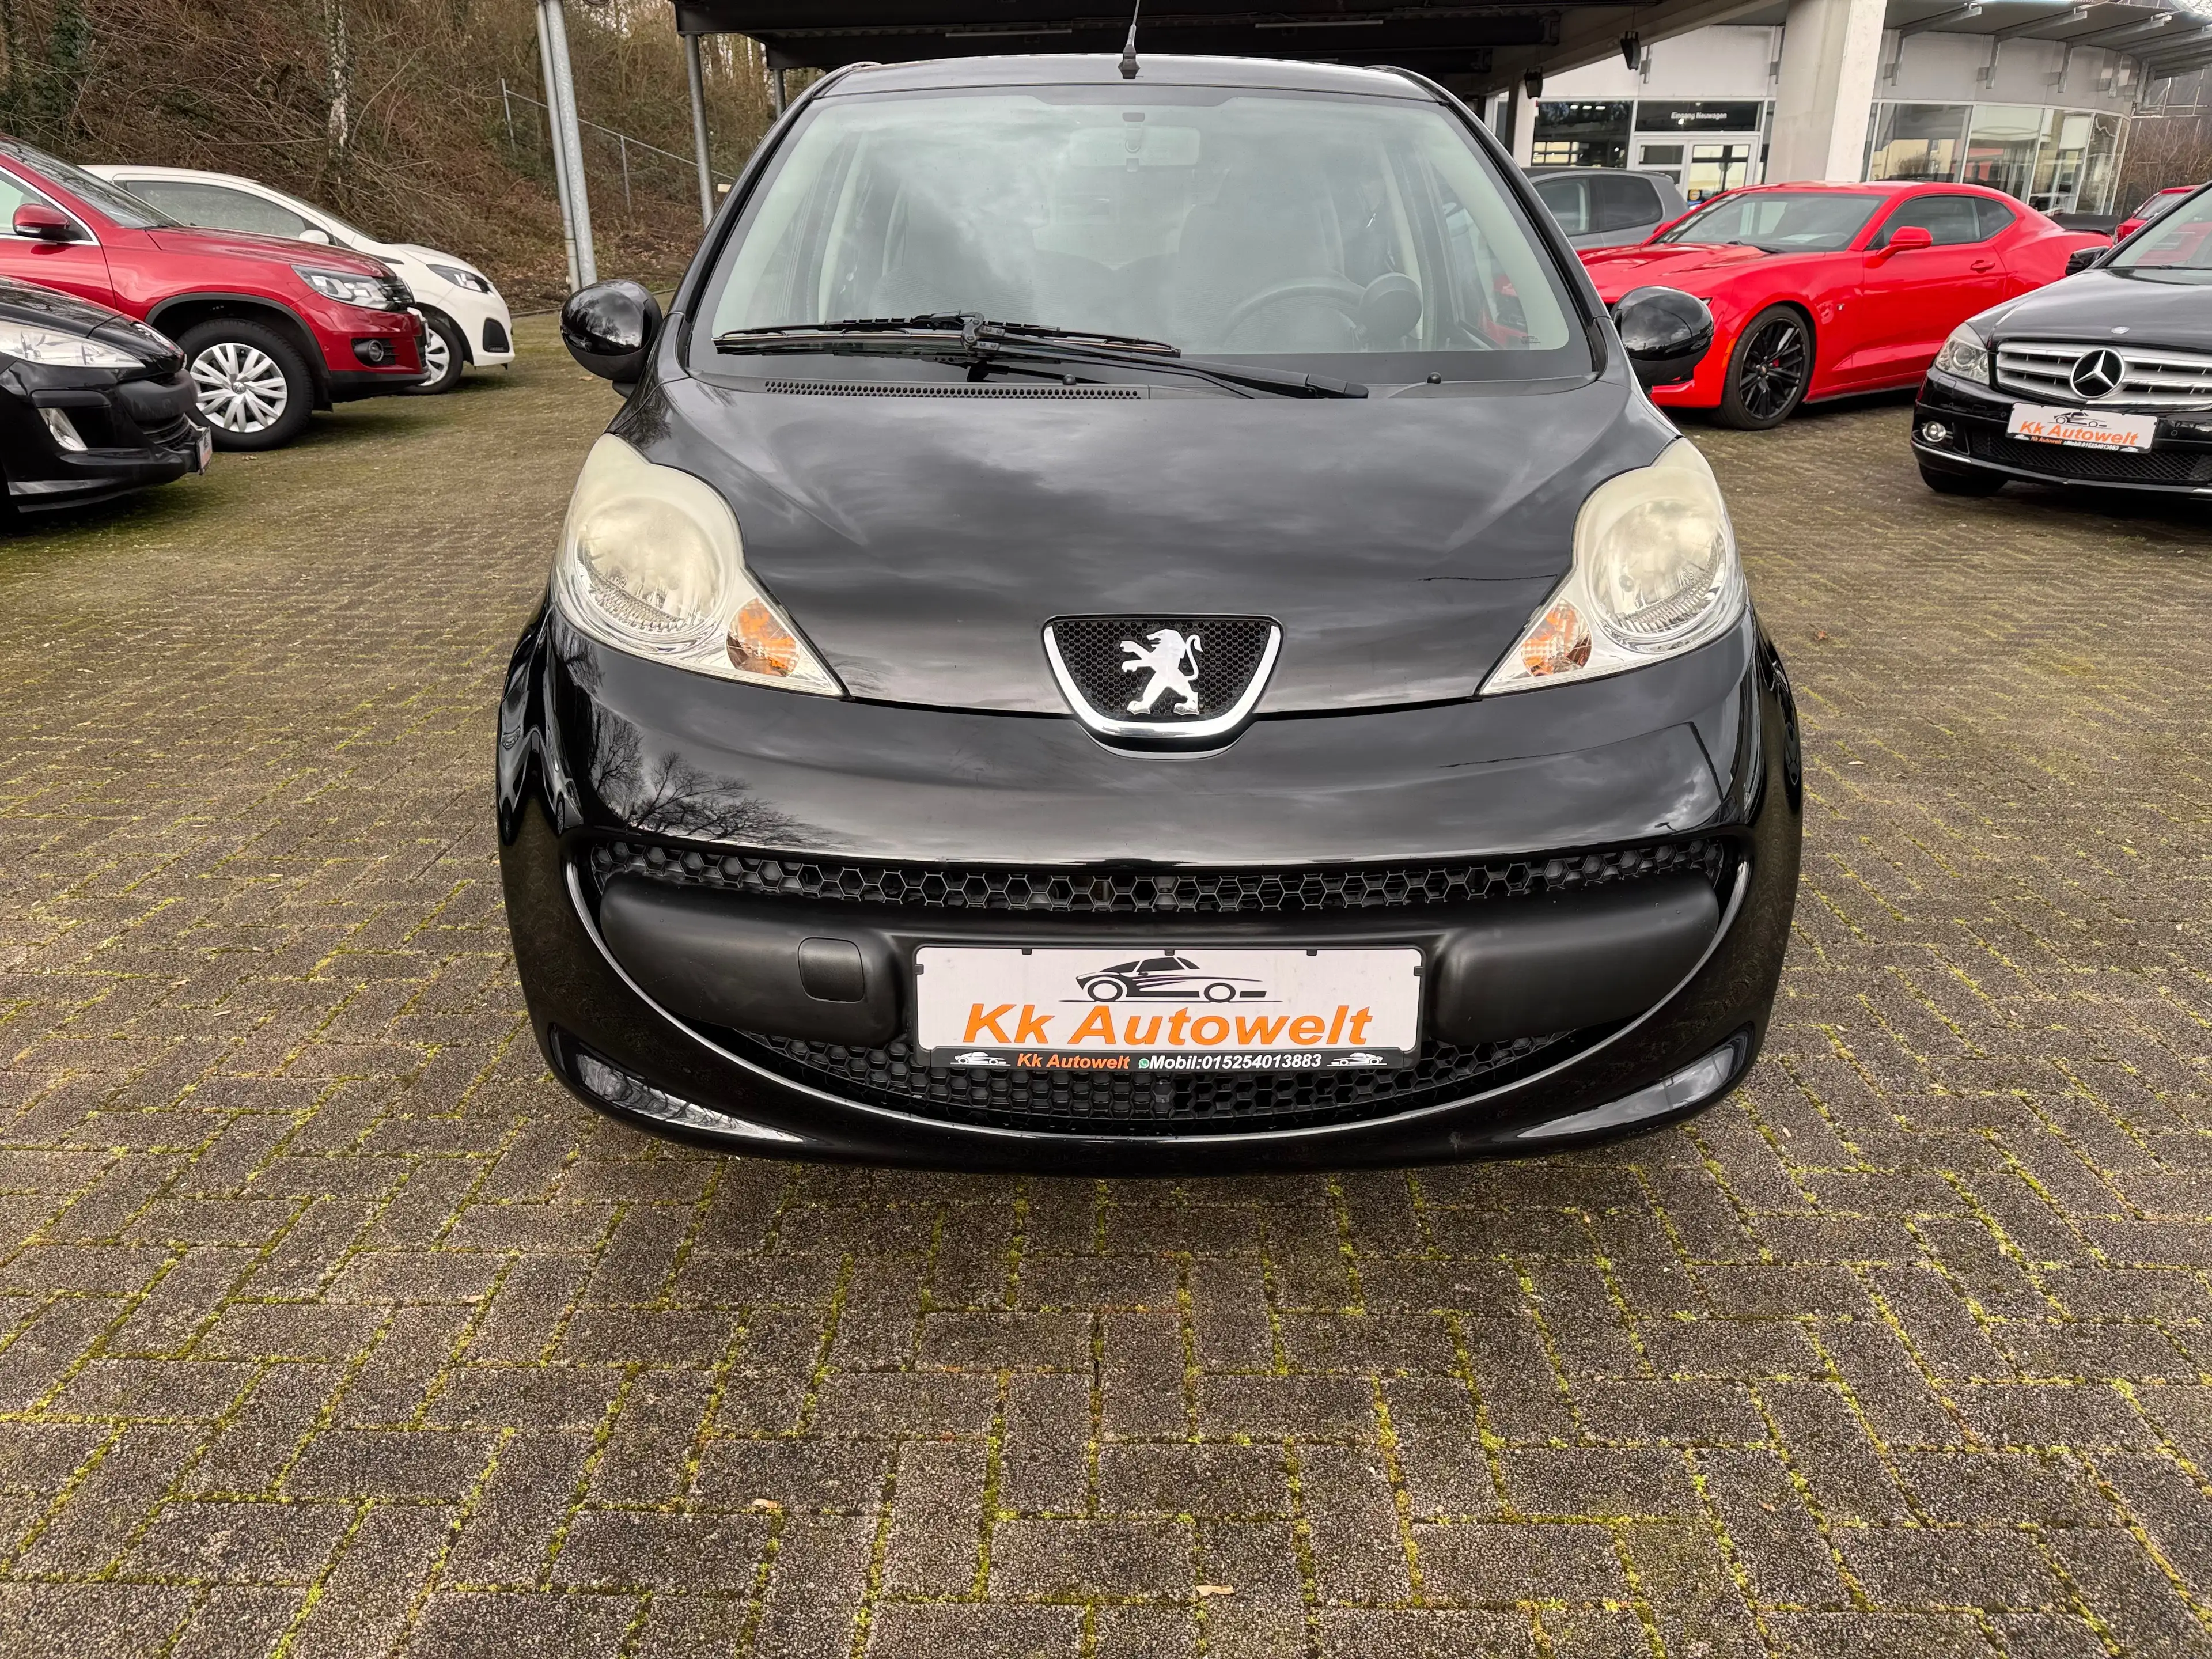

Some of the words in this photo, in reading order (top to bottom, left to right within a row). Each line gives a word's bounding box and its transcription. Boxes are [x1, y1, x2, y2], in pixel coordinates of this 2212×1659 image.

[2020, 421, 2045, 435] Kk
[2047, 424, 2139, 445] Autowelt
[963, 1003, 1055, 1044] Kk
[1067, 1005, 1373, 1046] Autowelt
[1017, 1053, 1043, 1067] Kk
[1046, 1054, 1131, 1069] Autowelt
[1149, 1054, 1322, 1069] Mobil:015254013883
